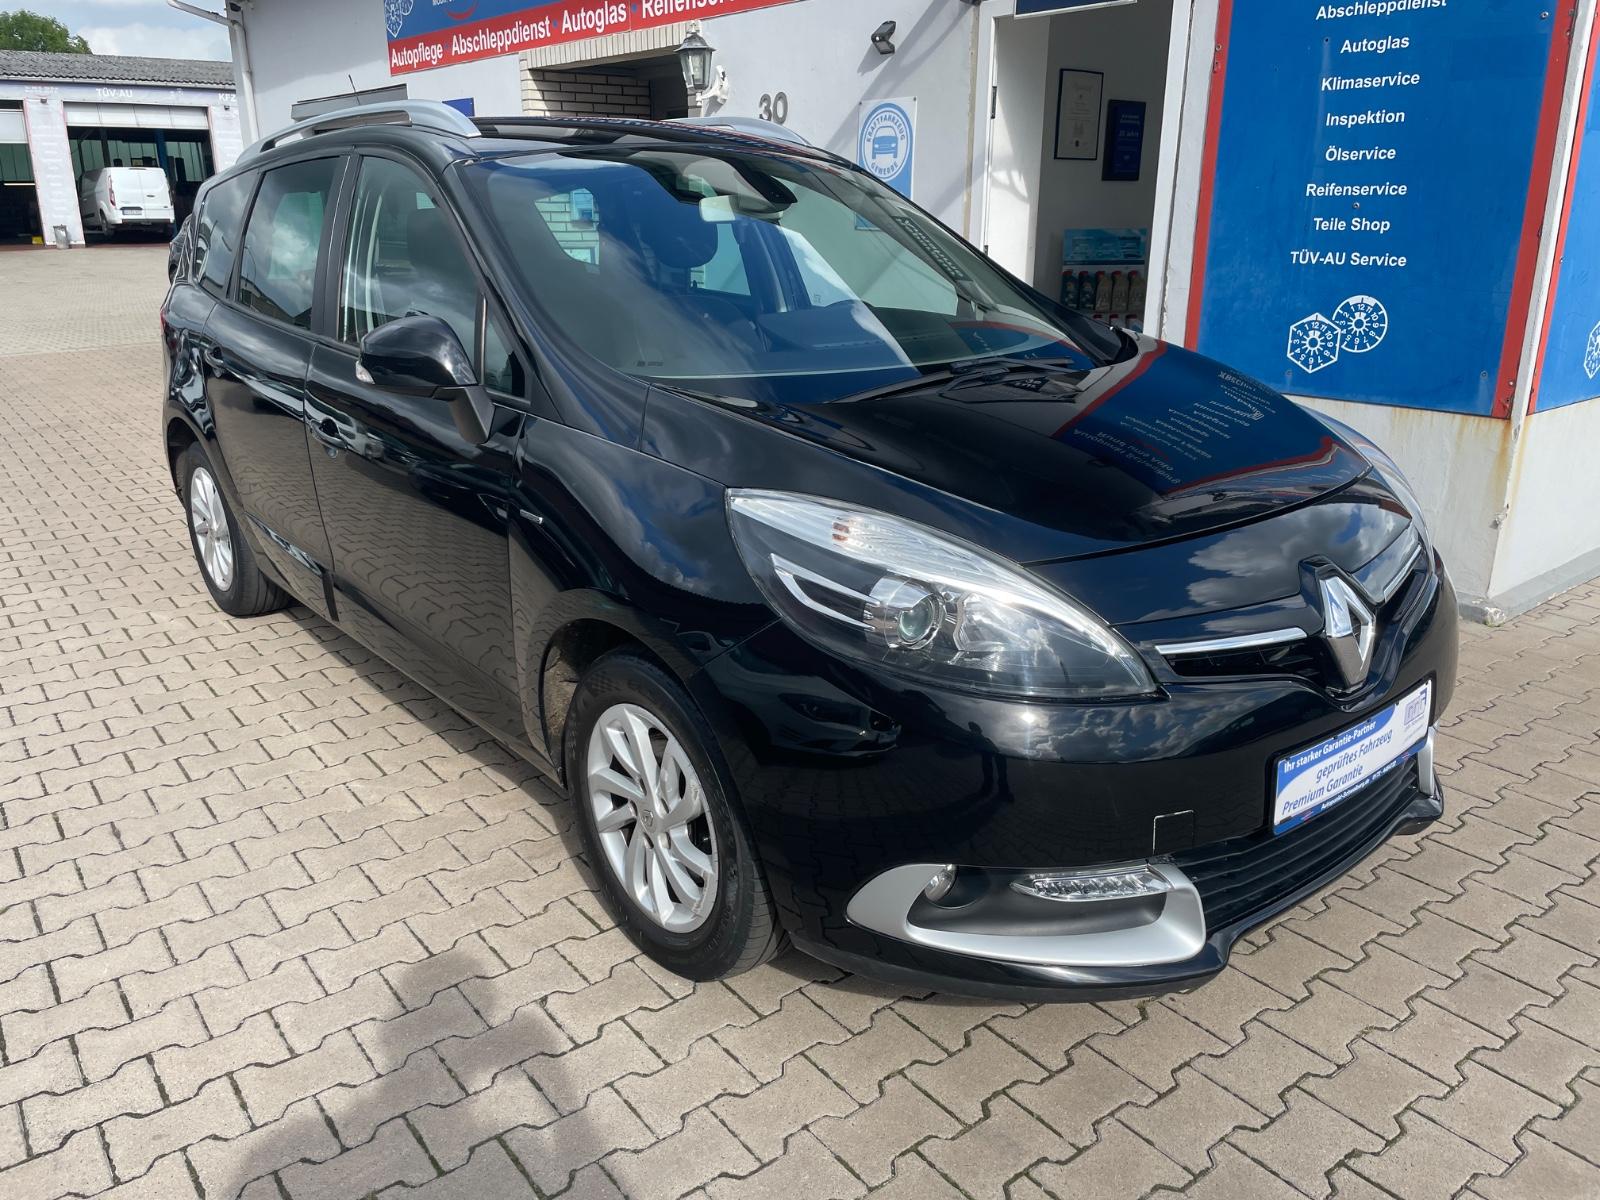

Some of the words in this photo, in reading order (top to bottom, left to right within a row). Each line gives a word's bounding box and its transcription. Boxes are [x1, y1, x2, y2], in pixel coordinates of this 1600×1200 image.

[391, 42, 443, 68] Autopflege
[451, 16, 551, 56] Abschleppdienst
[561, 3, 627, 35] Autoglas
[1340, 36, 1410, 54] Autoglas
[1321, 72, 1420, 91] Klimaservice
[95, 87, 133, 98] TÜV-AU
[759, 91, 788, 125] 30
[1326, 110, 1405, 128] Inspektion
[1325, 145, 1396, 161] Ölservice
[1305, 182, 1408, 196] Reifenservice
[1313, 217, 1346, 231] Teile
[1350, 217, 1391, 234] Shop
[1290, 249, 1346, 265] TÜV-AU
[1350, 252, 1407, 267] Service
[1284, 760, 1295, 773] Ihr
[1296, 749, 1322, 767] starker
[1322, 720, 1376, 755] Garantie-Partner
[1316, 749, 1357, 783] geprüftes
[1358, 728, 1393, 755] Fahrzeug
[1282, 787, 1324, 815] Premium
[1326, 765, 1364, 792] Garantie
